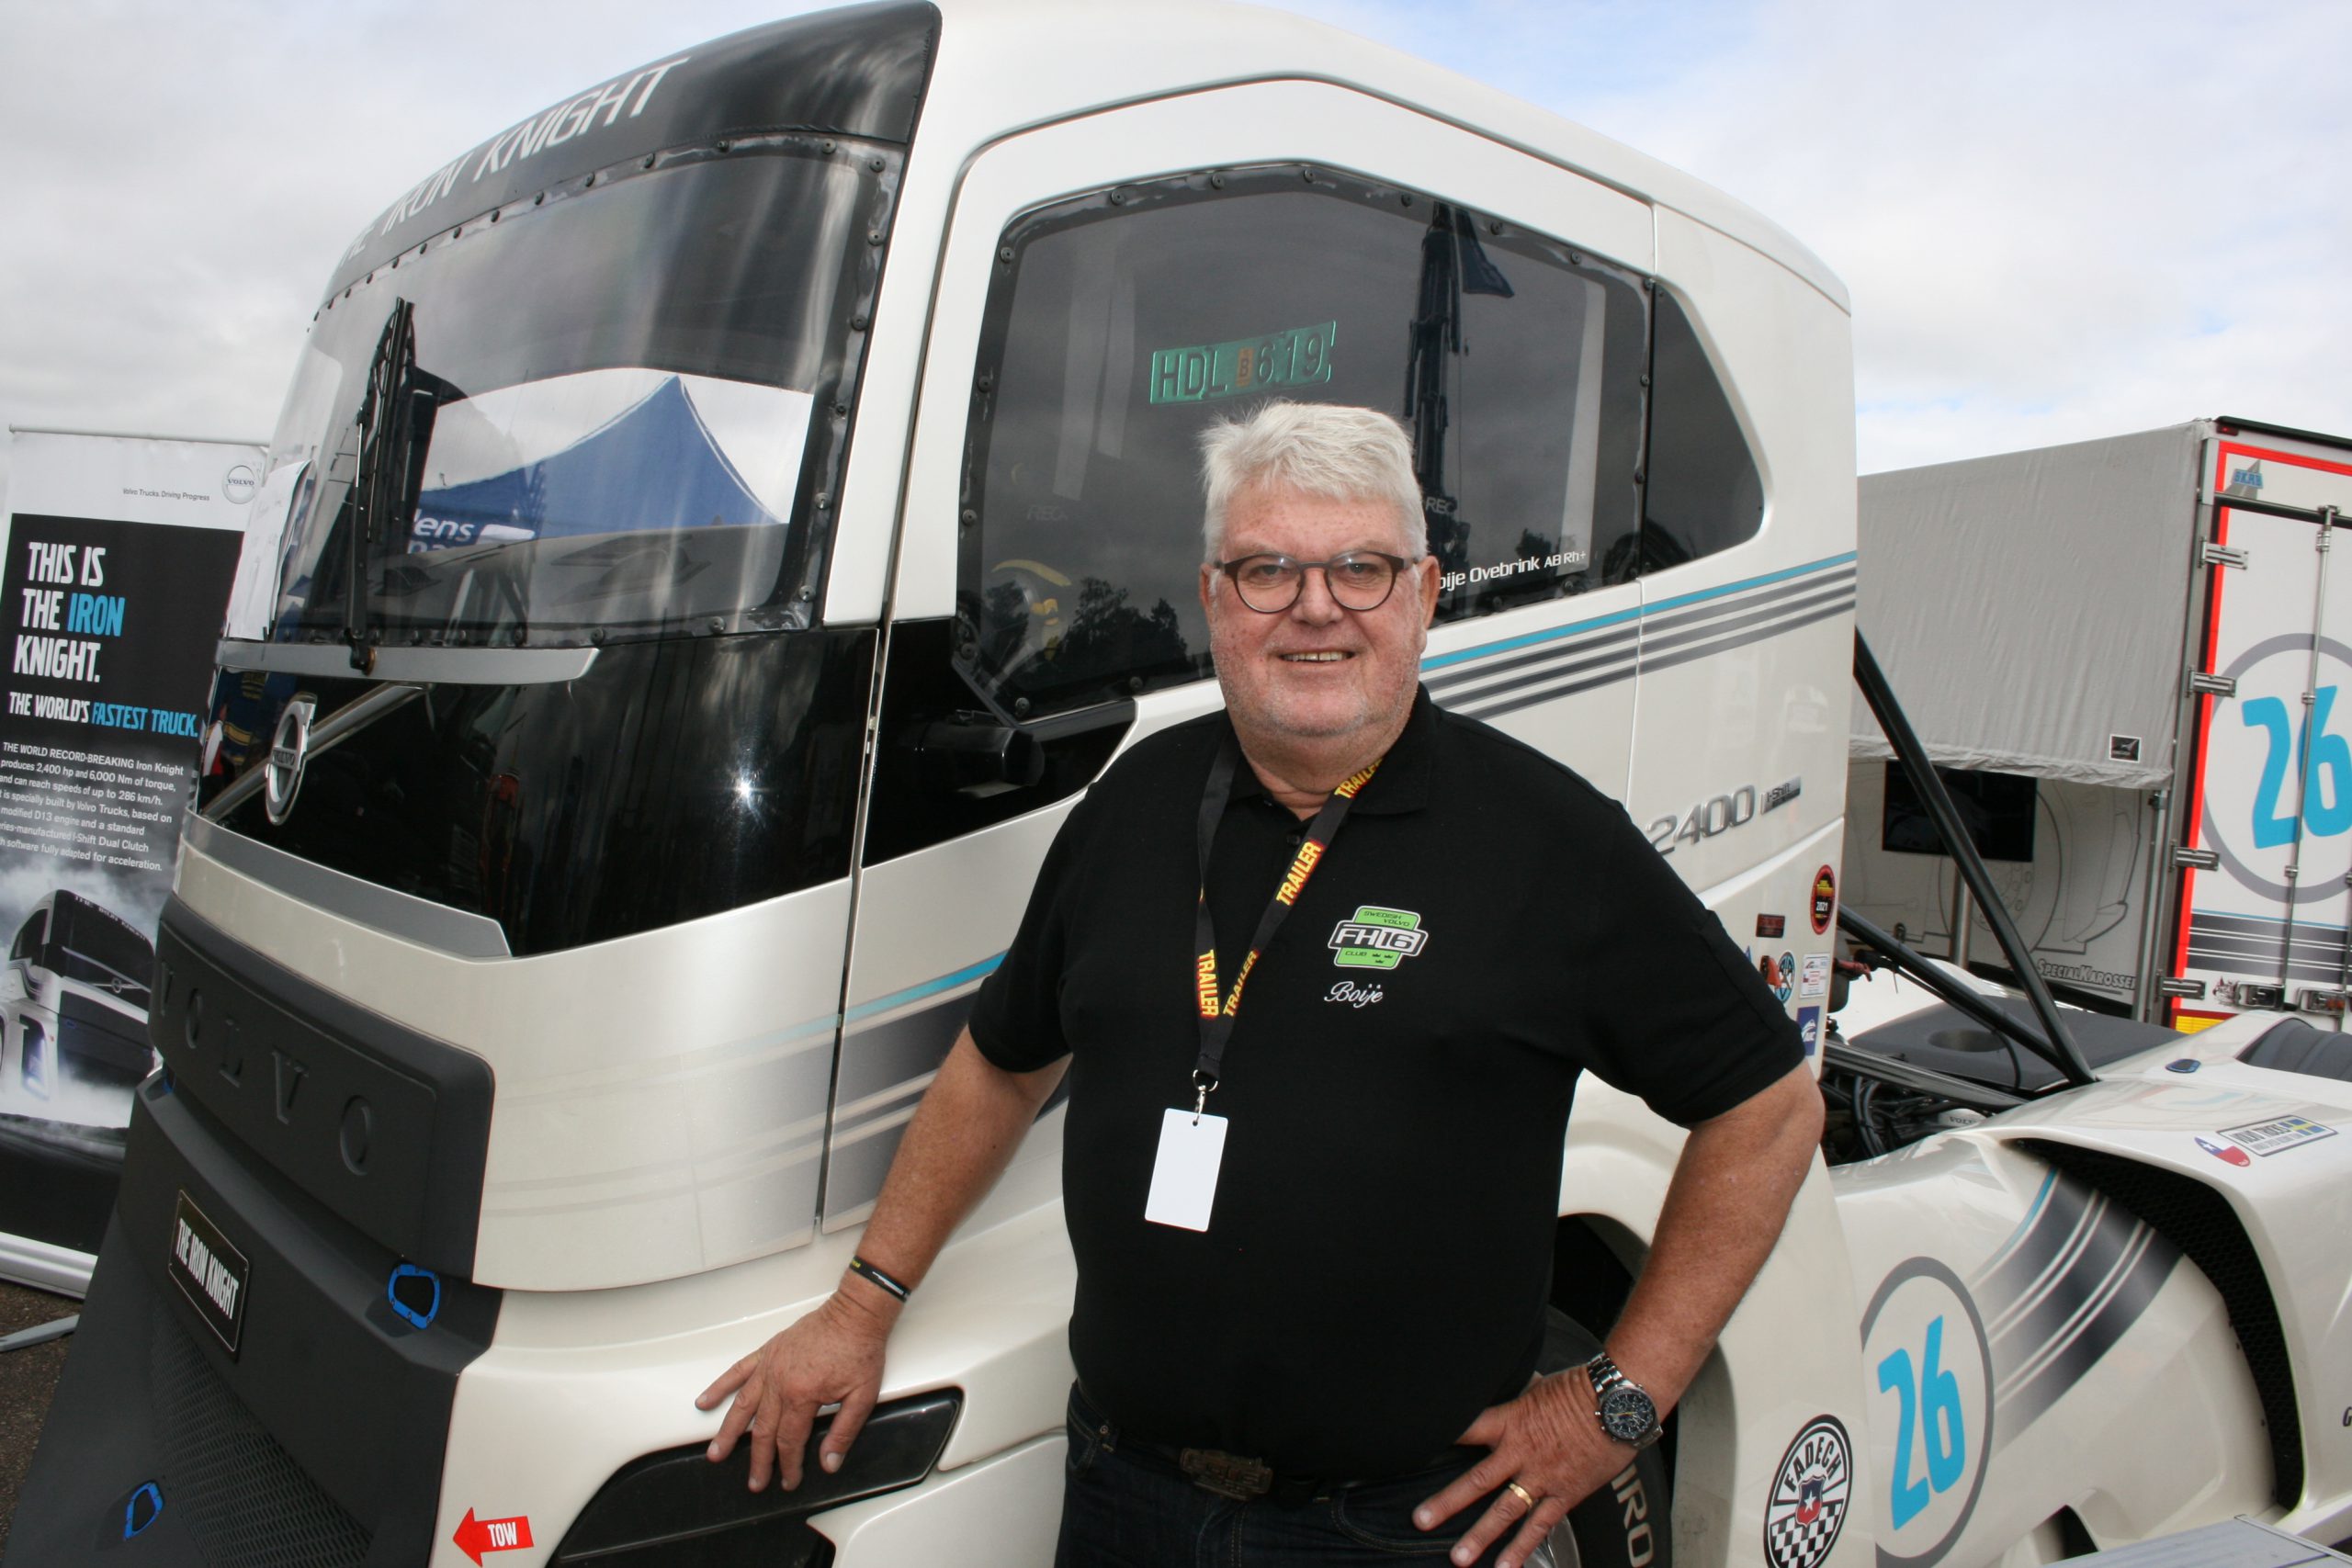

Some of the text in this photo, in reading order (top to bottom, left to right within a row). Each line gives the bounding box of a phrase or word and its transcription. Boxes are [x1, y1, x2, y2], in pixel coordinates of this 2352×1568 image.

[381, 151, 474, 236] IRON
[473, 56, 692, 182] KNIGHT
[1158, 350, 1227, 398] HDL
[1258, 333, 1324, 384] 619
[161, 491, 182, 500] Driving
[182, 492, 210, 502] Progress
[28, 542, 107, 587] THIS IS
[1439, 551, 1588, 592] oije Ovebrink AB Rh+
[22, 588, 126, 637] THE IRON
[13, 635, 101, 682] KNIGHT.
[8, 692, 198, 738] THE WORLD'S FASTEST TRUCK.
[1, 759, 176, 792] produces 2,400 hp and 6,000 Nm of torque,
[3, 741, 184, 776] THE WORLD RECORD-BREAKING Iron Knight
[2242, 685, 2352, 850] 26
[11, 792, 44, 806] specially
[45, 795, 64, 807] built
[66, 798, 75, 810] by
[77, 800, 96, 812] Volvo
[99, 804, 130, 818] Trucks,
[131, 808, 158, 821] based
[161, 814, 172, 823] on
[15, 777, 28, 786] can
[28, 779, 51, 790] reach
[52, 783, 82, 795] speeds
[83, 785, 91, 795] of
[92, 789, 104, 799] up
[107, 788, 116, 799] to
[119, 790, 136, 802] 286
[137, 793, 163, 806] km/h.
[0, 821, 73, 841] ries-manufactured
[98, 836, 119, 848] Dual
[121, 840, 149, 852] Clutch
[1, 807, 33, 818] modified
[34, 810, 52, 821] D13
[54, 815, 80, 827] engine
[81, 819, 96, 829] and
[107, 822, 145, 836] standard
[1646, 784, 1755, 856] 2400
[7, 839, 39, 852] software
[41, 843, 59, 856] fully
[60, 847, 90, 860] adapted
[93, 852, 107, 863] for
[108, 856, 162, 872] acceleration.
[1276, 839, 1326, 906] TRAILER
[1363, 910, 1402, 919] SWEDISH
[1384, 919, 1410, 927] VOLVO
[1335, 928, 1415, 950] FH16
[1197, 949, 1219, 1019] TRAILER
[1223, 949, 1260, 1017] TRAILER
[1324, 981, 1384, 1009] Boije
[161, 961, 372, 1177] VOLVO
[175, 1217, 239, 1320] THE IRON KNIGHT
[1877, 1314, 1965, 1531] 26
[1784, 1436, 1842, 1494] FADECH
[487, 1521, 517, 1548] TOW
[1611, 1462, 1655, 1568] IRO
